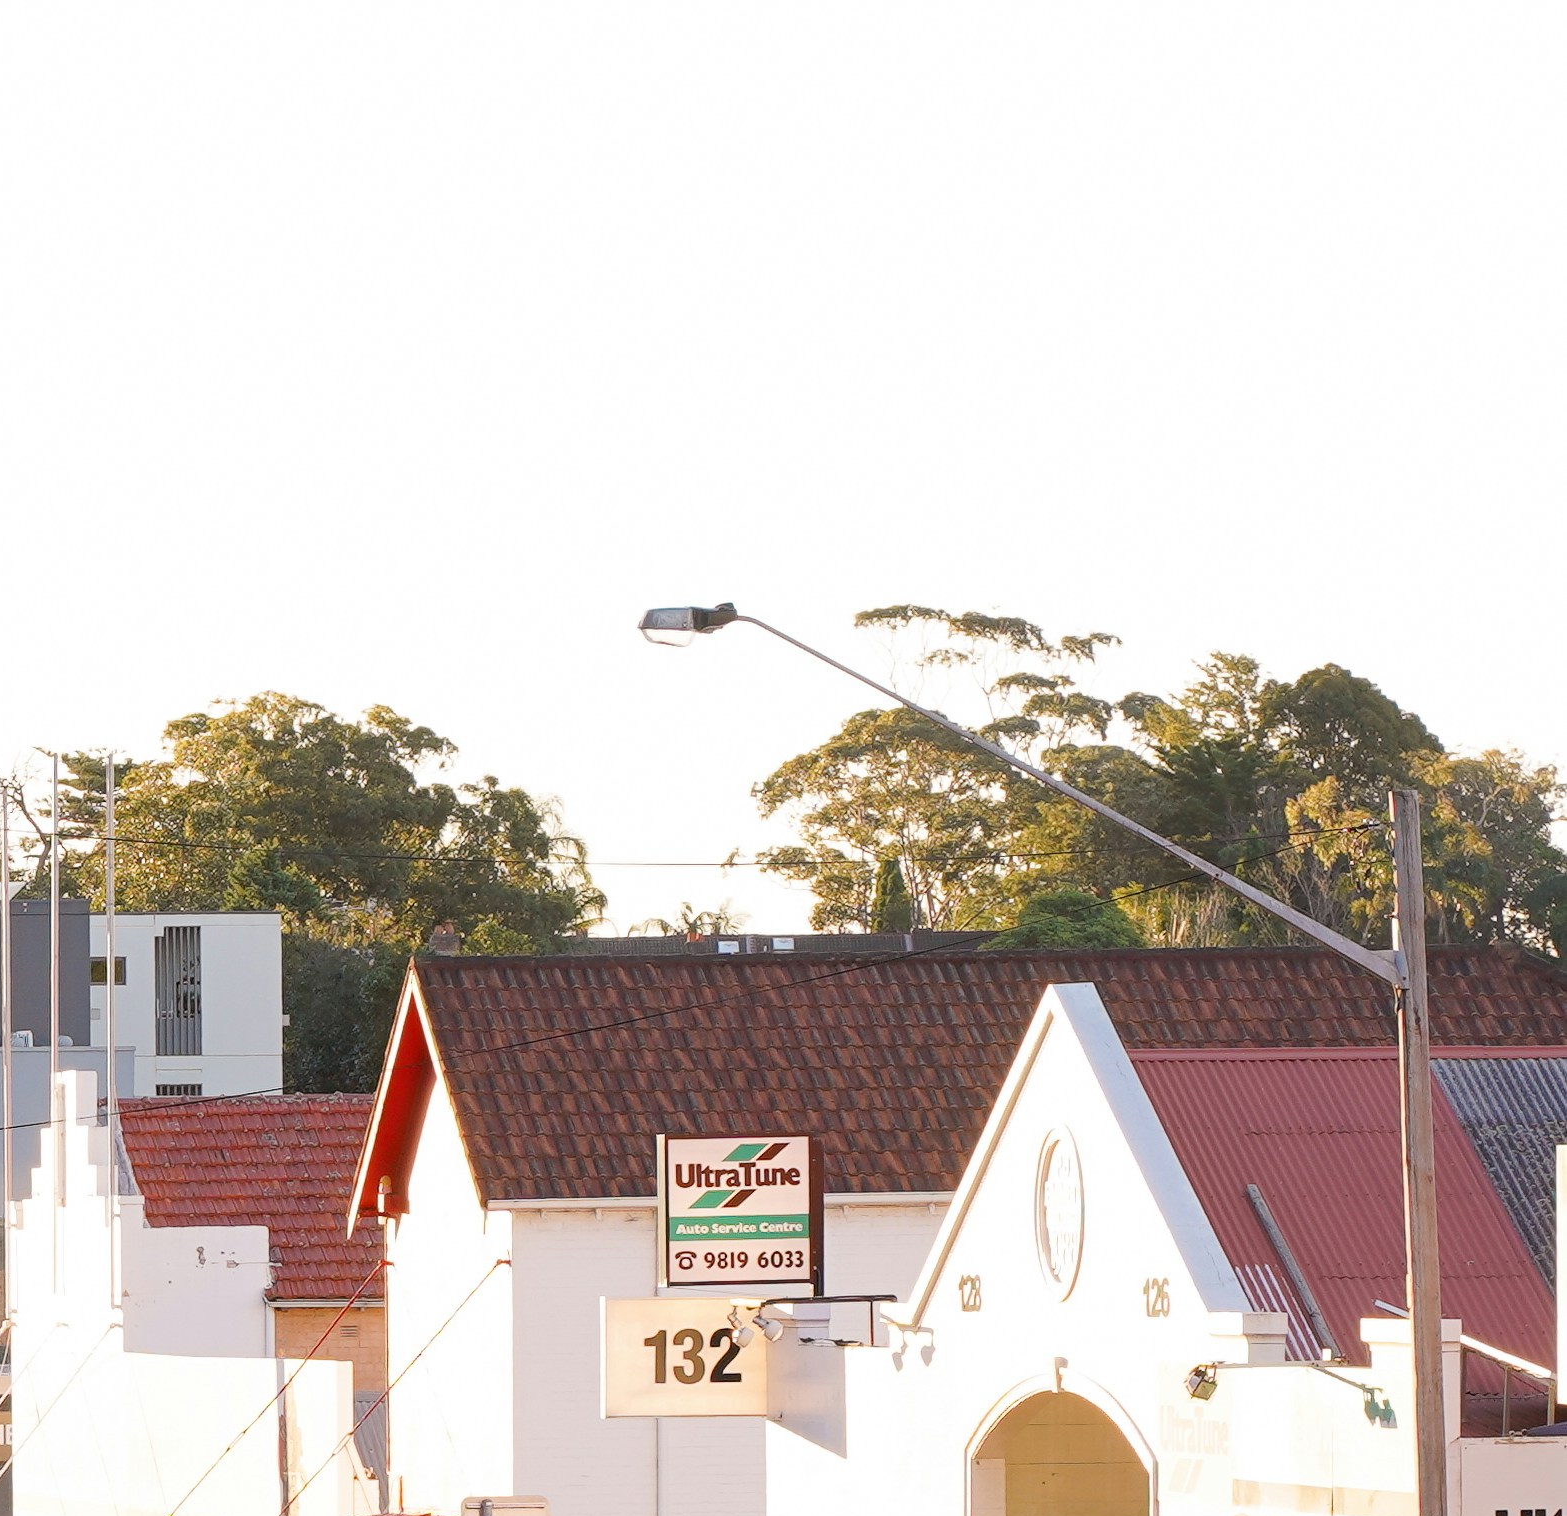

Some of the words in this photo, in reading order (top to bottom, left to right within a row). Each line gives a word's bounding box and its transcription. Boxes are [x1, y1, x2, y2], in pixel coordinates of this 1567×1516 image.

[676, 1222, 709, 1235] Auto
[711, 1222, 757, 1234] Service
[759, 1221, 804, 1233] Centre
[704, 1252, 749, 1269] 9819
[757, 1251, 805, 1268] 6033
[644, 1328, 743, 1384] 132
